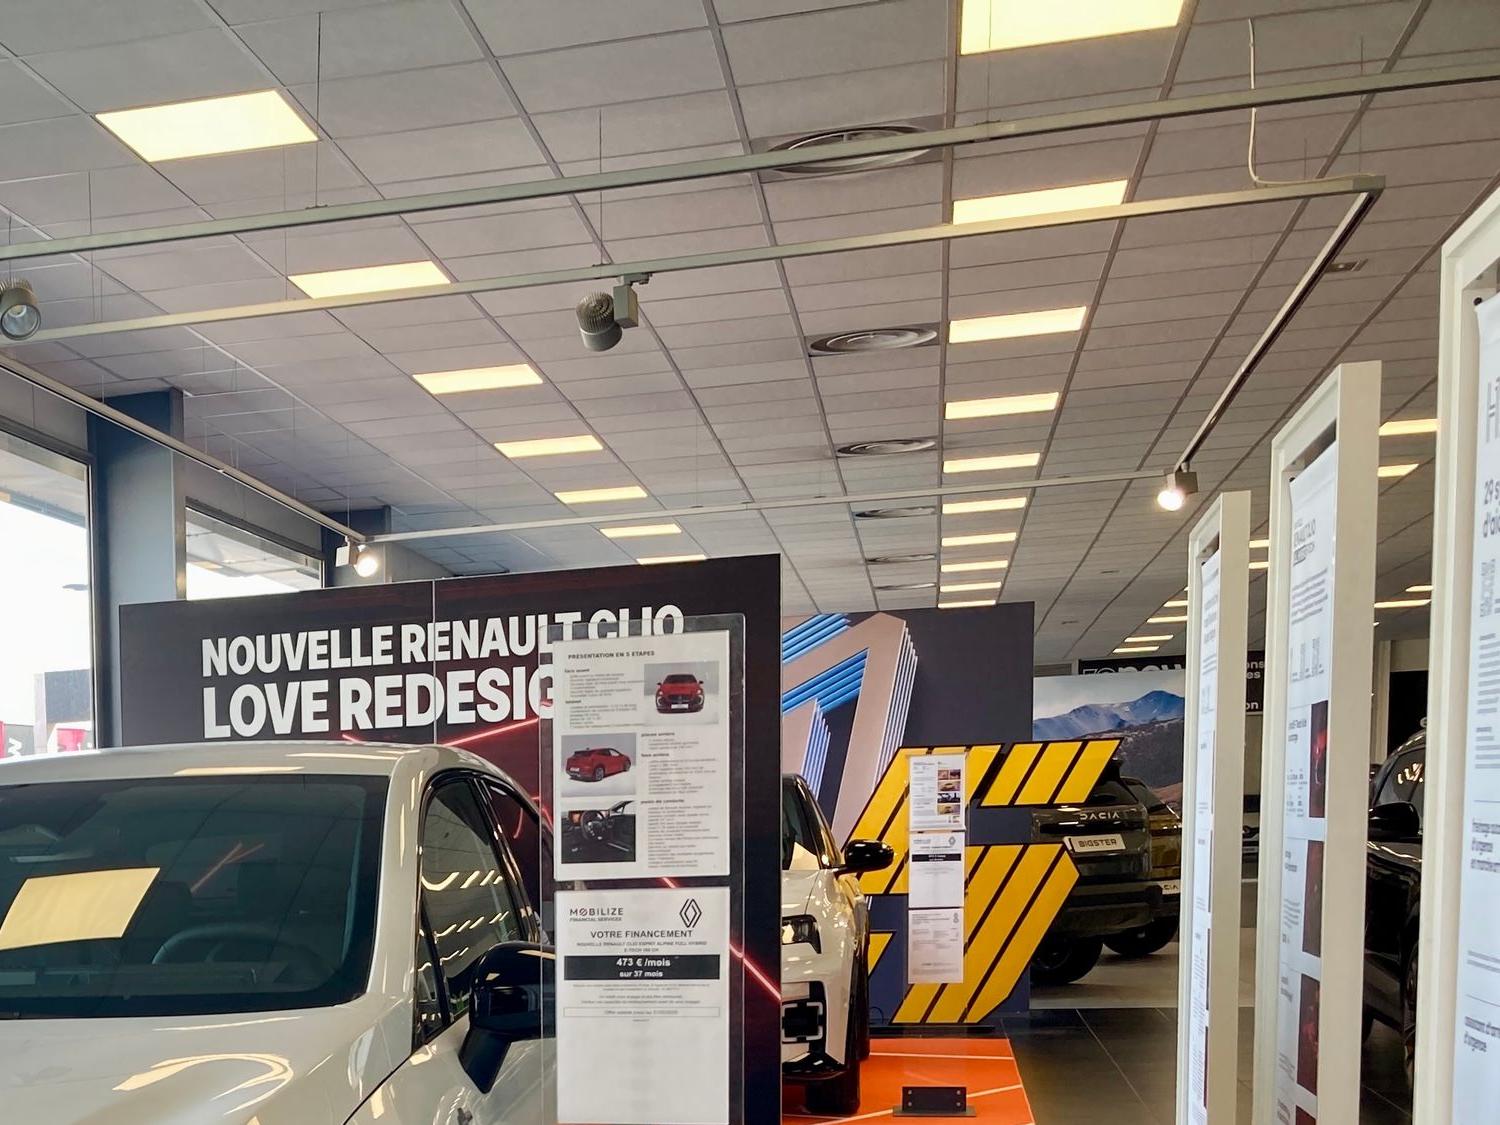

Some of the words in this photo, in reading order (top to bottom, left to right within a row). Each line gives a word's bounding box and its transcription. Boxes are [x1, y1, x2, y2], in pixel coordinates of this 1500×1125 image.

[202, 625, 393, 677] NOUVELLE
[402, 612, 579, 664] RENAULT
[203, 680, 329, 739] LOVE
[340, 664, 554, 731] REDESIG
[1080, 812, 1120, 820] DACIA
[1078, 839, 1117, 848] BIGSTER
[625, 930, 692, 938] FINANCEMENT
[616, 958, 633, 967] 473
[644, 958, 670, 967] /mois
